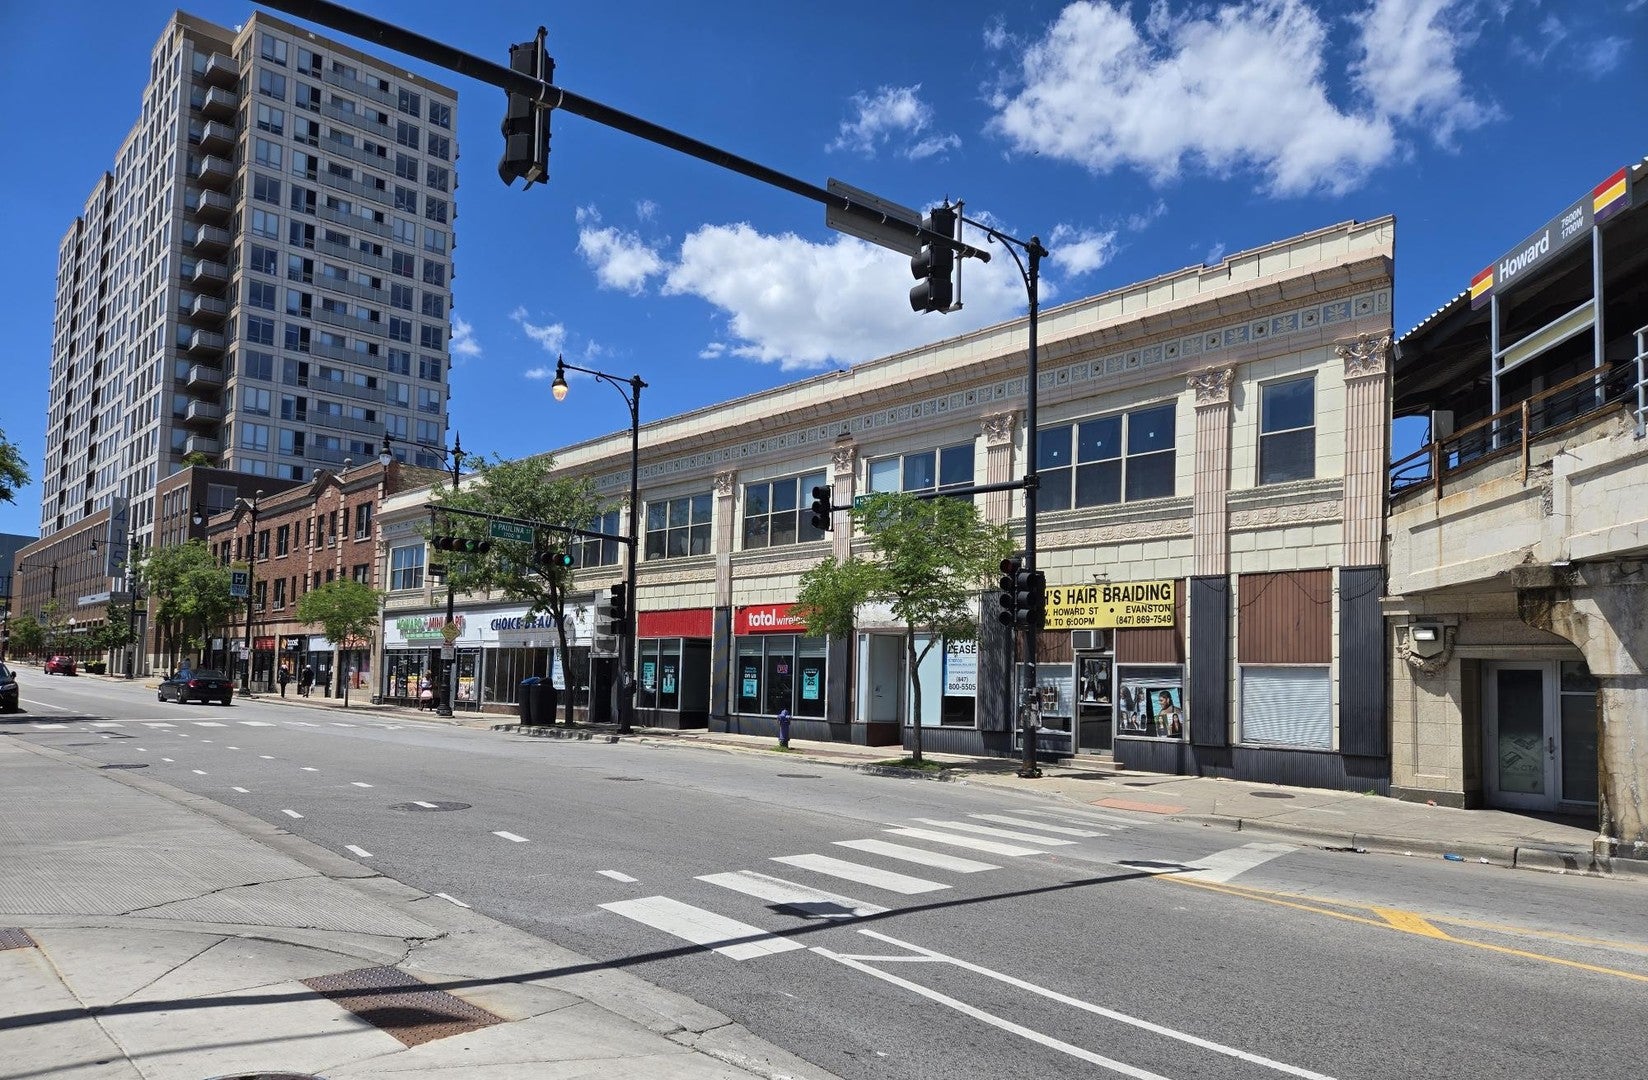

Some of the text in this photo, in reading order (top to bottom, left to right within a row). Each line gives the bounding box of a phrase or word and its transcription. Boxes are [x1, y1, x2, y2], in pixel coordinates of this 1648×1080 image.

[1561, 216, 1584, 240] 1700W
[1499, 230, 1550, 283] Howard
[497, 523, 525, 534] PAULINA
[1067, 588, 1097, 604] HAIR
[1103, 583, 1171, 603] BRAIDING
[1053, 607, 1085, 616] HOWARD
[1089, 607, 1099, 615] ST
[1126, 604, 1171, 613] EVANSTON
[491, 616, 521, 631] CHOICE
[748, 609, 776, 627] total
[1054, 618, 1063, 626] TO
[1066, 617, 1095, 626] 6:00PM
[1116, 616, 1134, 625] (847)
[1136, 614, 1172, 624] 869-7549
[948, 644, 977, 654] LEASE
